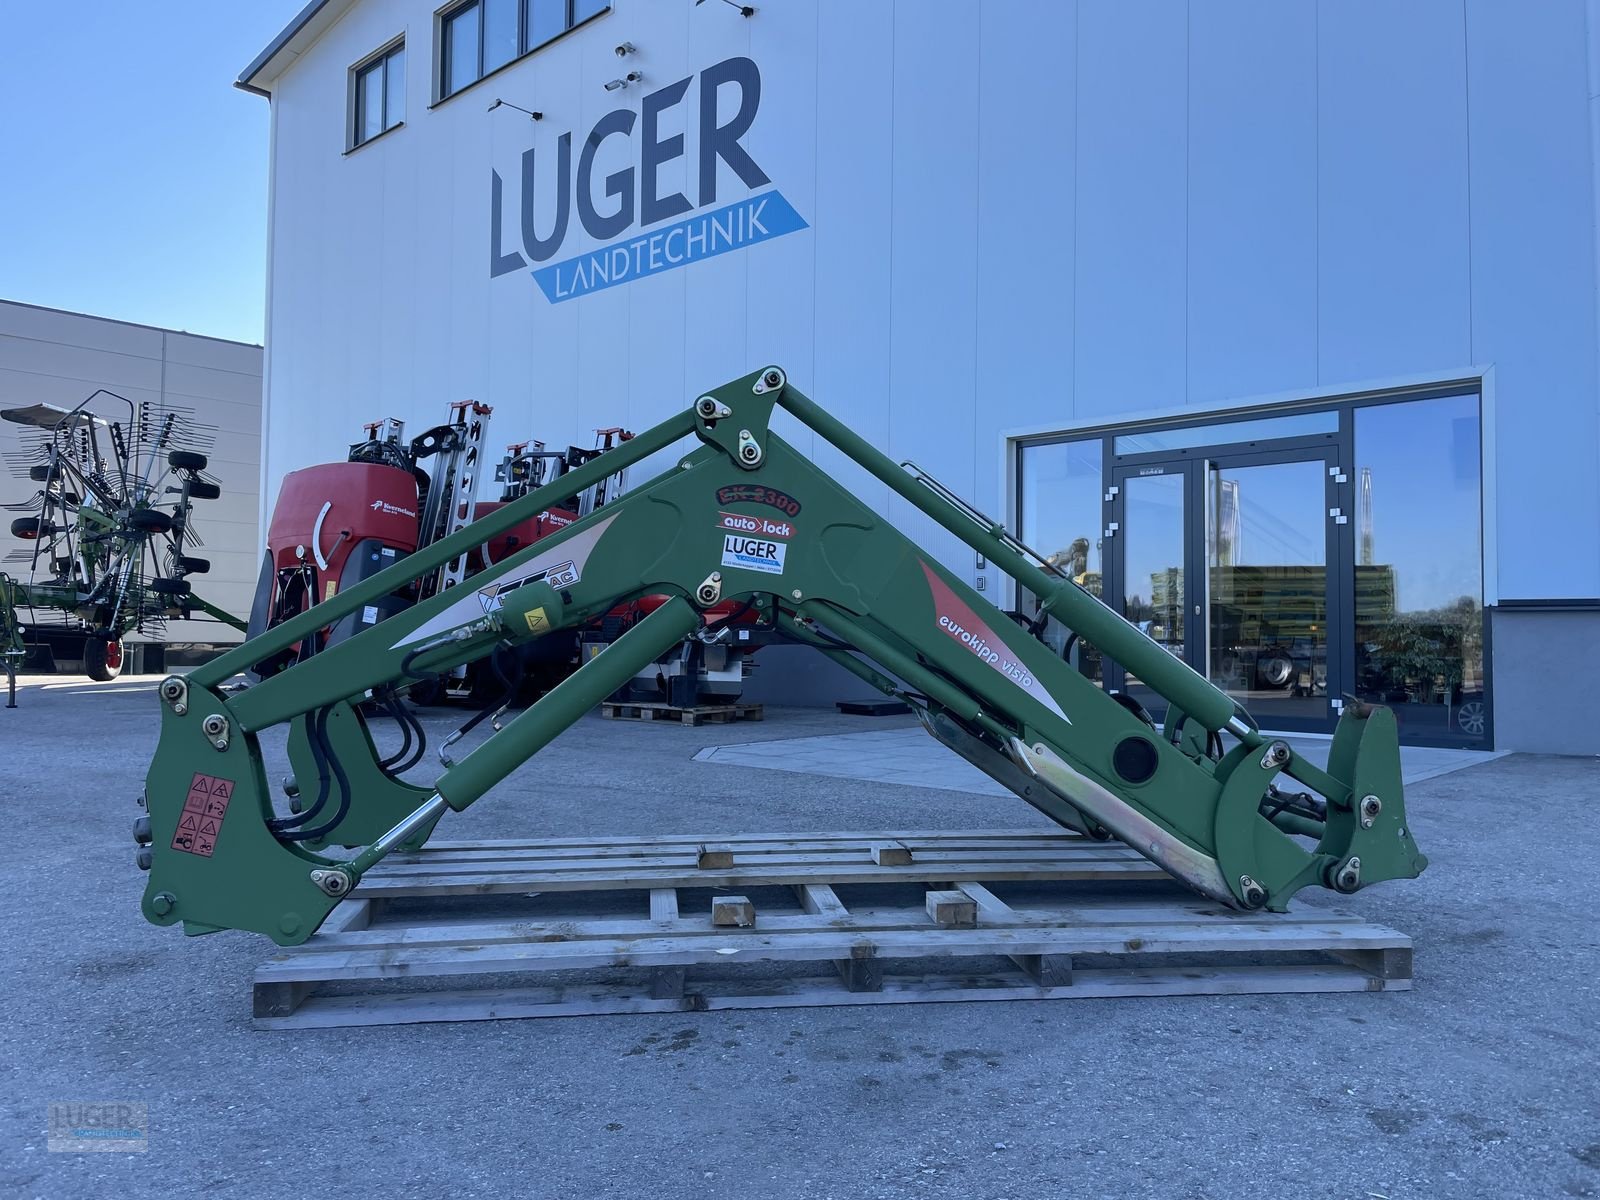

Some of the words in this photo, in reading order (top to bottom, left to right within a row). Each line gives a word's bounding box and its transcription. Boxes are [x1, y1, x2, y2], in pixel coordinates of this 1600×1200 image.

[490, 56, 772, 279] LUGER
[555, 199, 770, 298] LANDTECHNIK
[384, 502, 416, 518] Kverneland
[550, 513, 574, 526] Kvernel
[724, 516, 756, 531] auto
[763, 520, 790, 537] lock
[725, 537, 777, 560] LUGER
[939, 615, 1000, 664] eurokipp
[1002, 658, 1033, 687] visio
